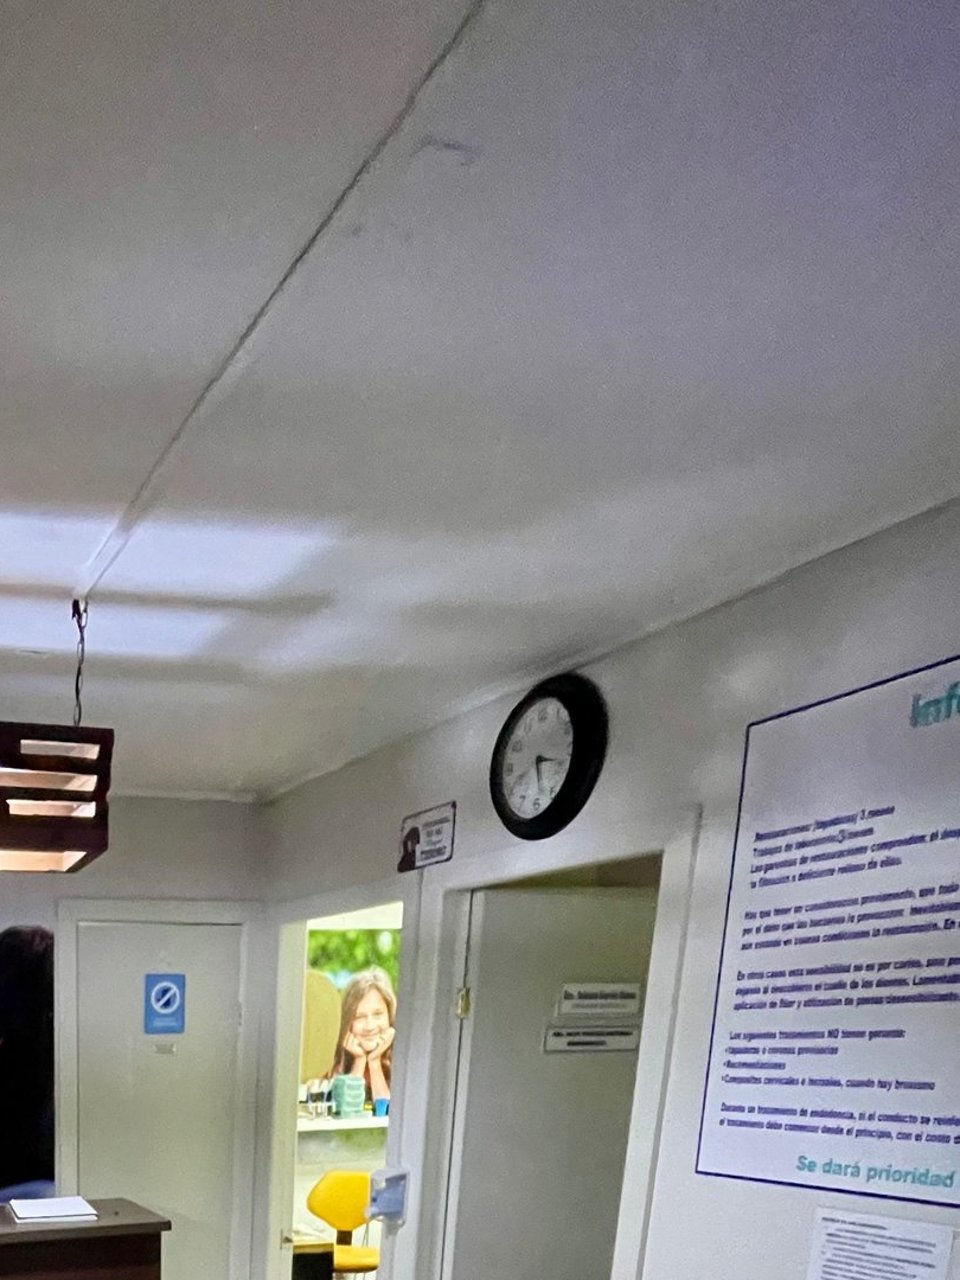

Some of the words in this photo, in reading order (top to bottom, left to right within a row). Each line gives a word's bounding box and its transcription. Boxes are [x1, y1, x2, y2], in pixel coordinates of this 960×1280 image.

[909, 681, 960, 728] Inf
[796, 1154, 818, 1172] Se
[822, 1157, 860, 1178] dará
[866, 1163, 958, 1189] prioridad
